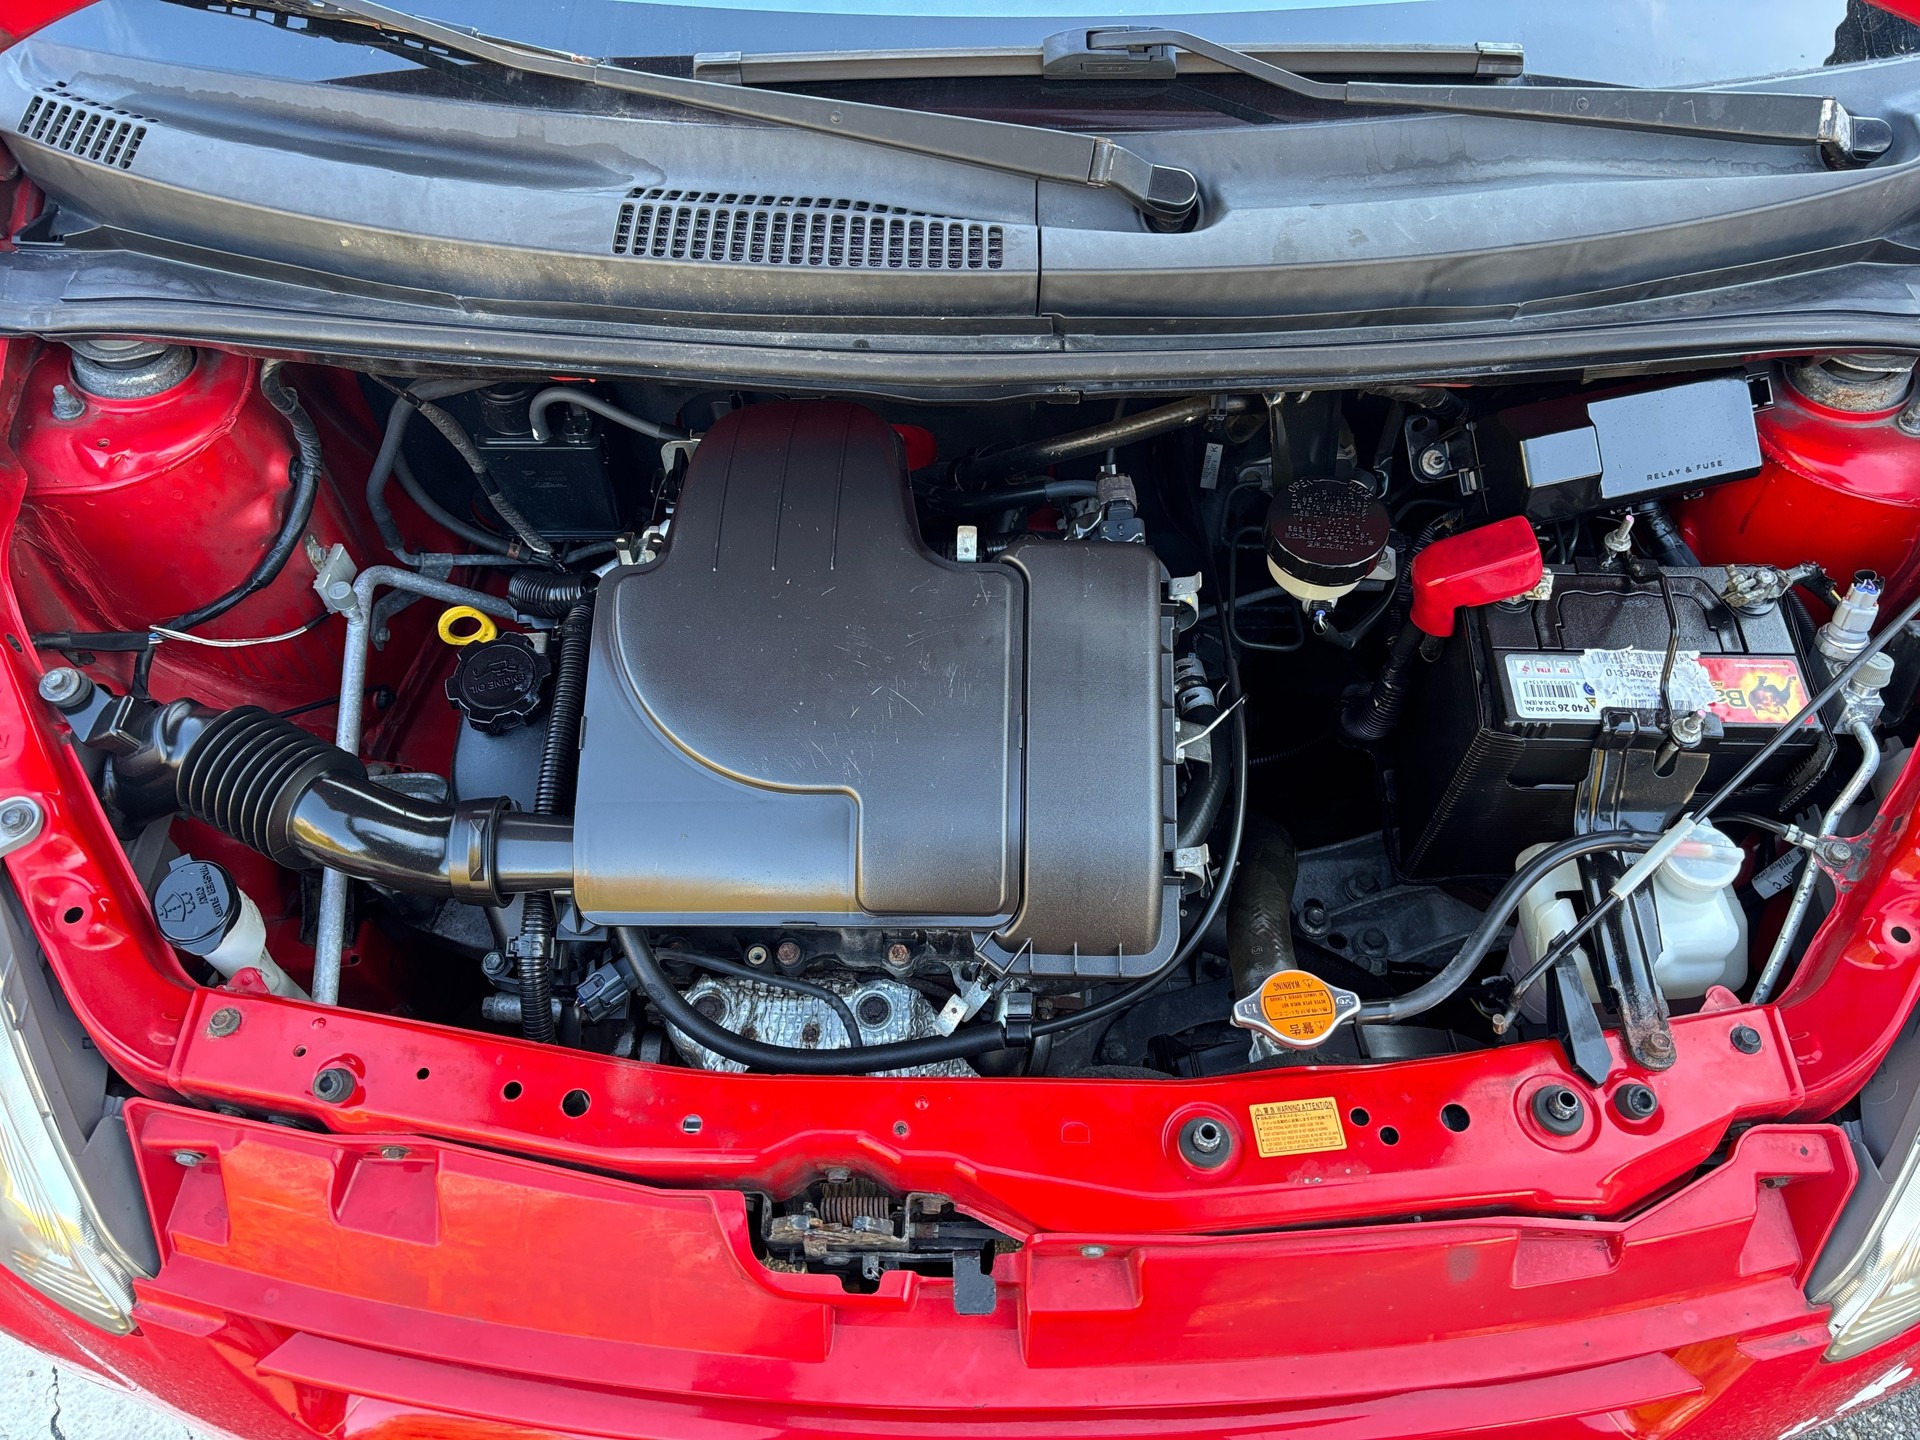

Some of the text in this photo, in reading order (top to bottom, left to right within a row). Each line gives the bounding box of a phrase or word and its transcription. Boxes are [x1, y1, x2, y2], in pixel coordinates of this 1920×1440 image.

[1646, 460, 1723, 481] RELAY & FUSE
[1287, 478, 1314, 493] OPEN
[1347, 480, 1374, 500] CLOSE
[469, 673, 524, 694] ENGINE OIL
[1557, 703, 1570, 712] 26
[1571, 704, 1590, 713] P40
[196, 886, 208, 905] ONLY
[200, 864, 224, 918] WASHER FLUID
[1273, 981, 1300, 991] WARNING
[1289, 1021, 1315, 1036] 警告
[1276, 1103, 1300, 1113] WARNING
[1301, 1100, 1334, 1111] ATTENTION
